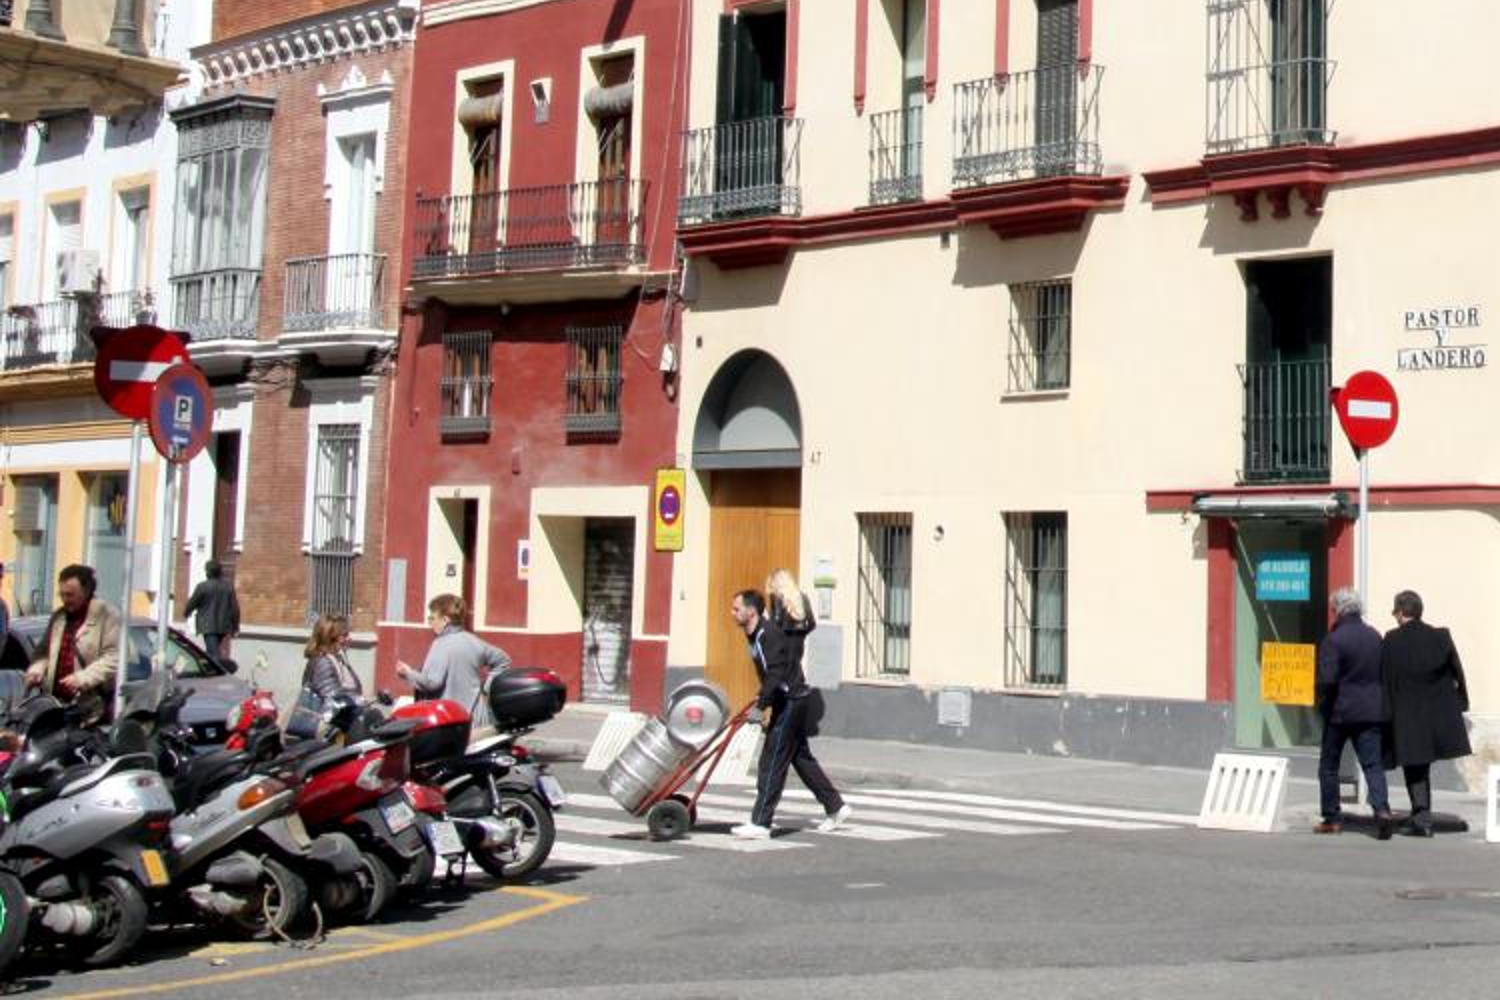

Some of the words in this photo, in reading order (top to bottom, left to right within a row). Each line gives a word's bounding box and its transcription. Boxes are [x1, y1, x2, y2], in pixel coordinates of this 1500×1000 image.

[1404, 308, 1480, 328] PASTOR
[1435, 329, 1446, 346] Y
[1397, 350, 1487, 370] LANDERO
